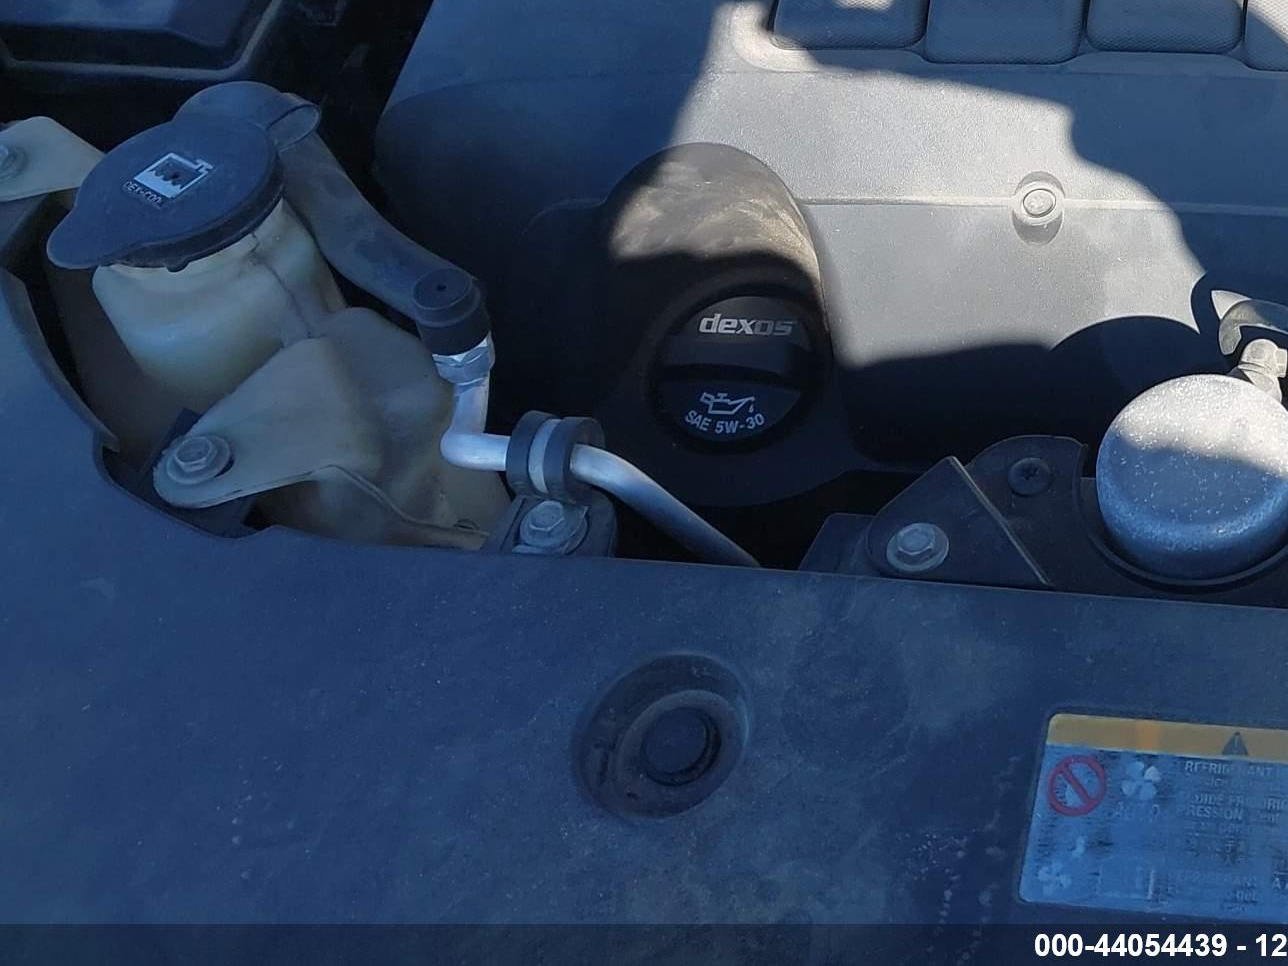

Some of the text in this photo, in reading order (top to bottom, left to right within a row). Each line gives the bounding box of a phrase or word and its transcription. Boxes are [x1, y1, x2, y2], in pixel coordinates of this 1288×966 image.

[698, 313, 796, 337] dexos
[685, 410, 765, 435] SAE 5W-30
